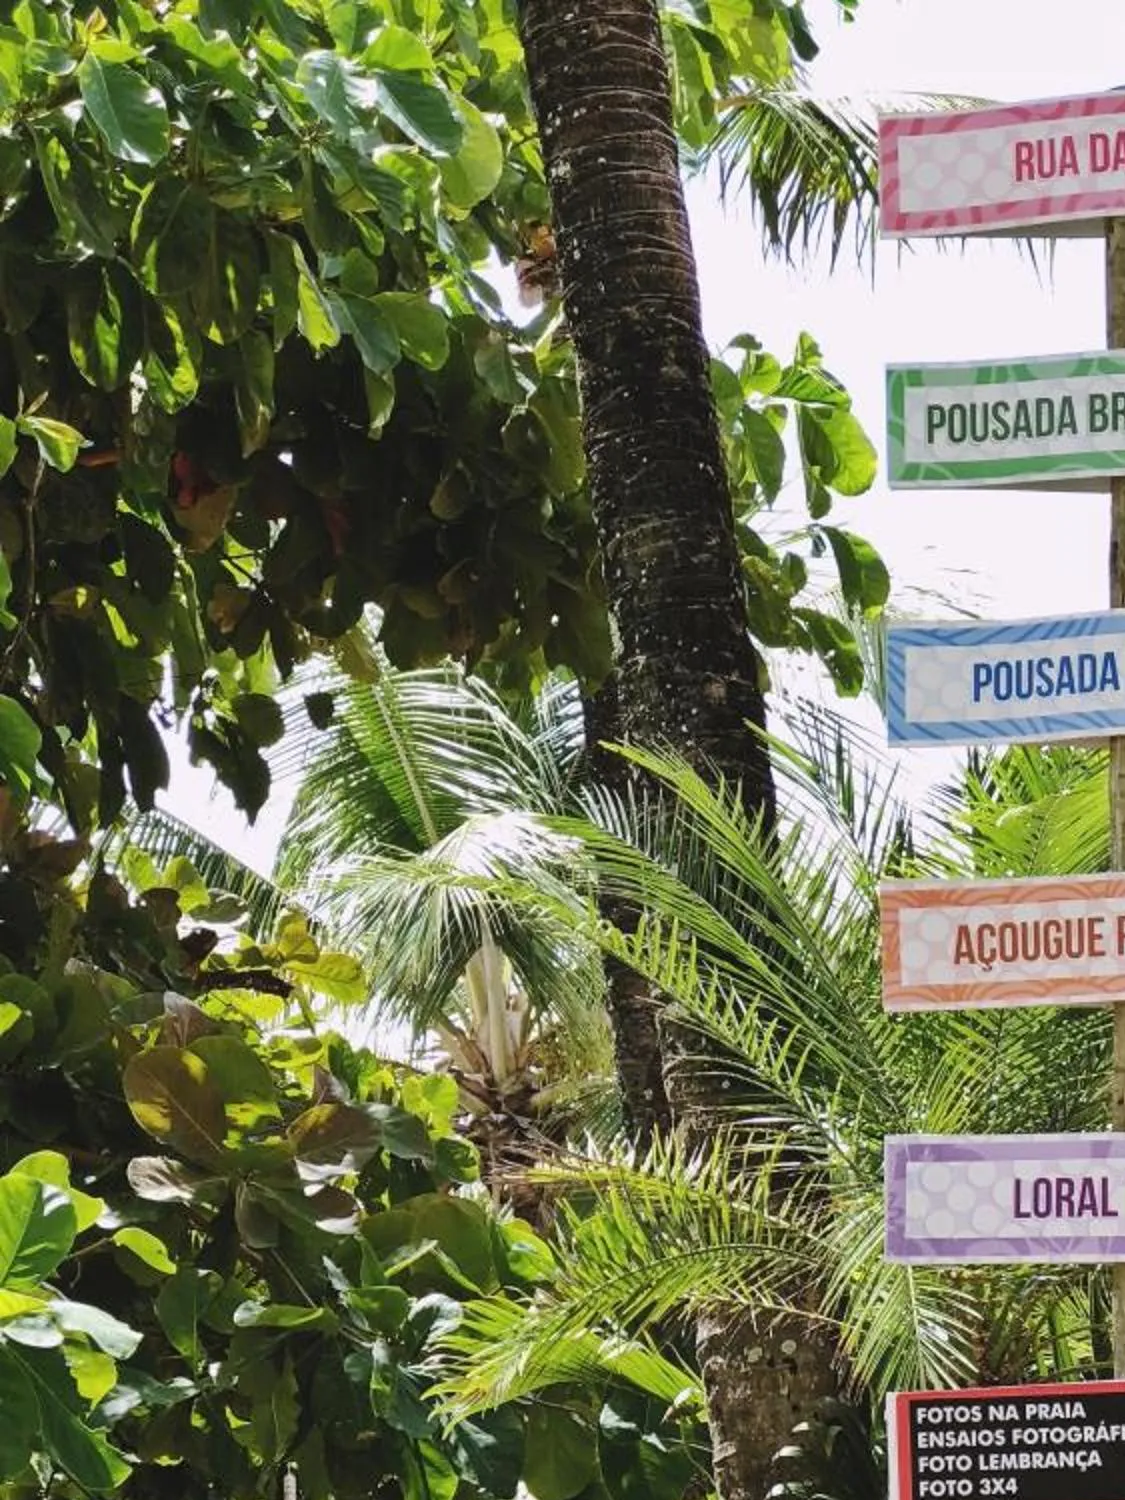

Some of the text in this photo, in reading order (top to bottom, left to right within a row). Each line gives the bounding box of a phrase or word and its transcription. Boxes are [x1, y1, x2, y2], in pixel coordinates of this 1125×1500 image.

[1014, 135, 1081, 182] RUA
[926, 394, 1079, 444] POUSADA
[972, 651, 1121, 703] POUSADA
[953, 916, 1106, 973] AÇOUGUE
[1013, 1175, 1119, 1219] LORAL
[916, 1401, 1087, 1425] FOTOS NA PRAIA
[917, 1427, 1006, 1449] ENSAIOS
[918, 1449, 1103, 1474] FOTO LEMBRANÇA
[918, 1477, 1019, 1497] FOTO 3X4
